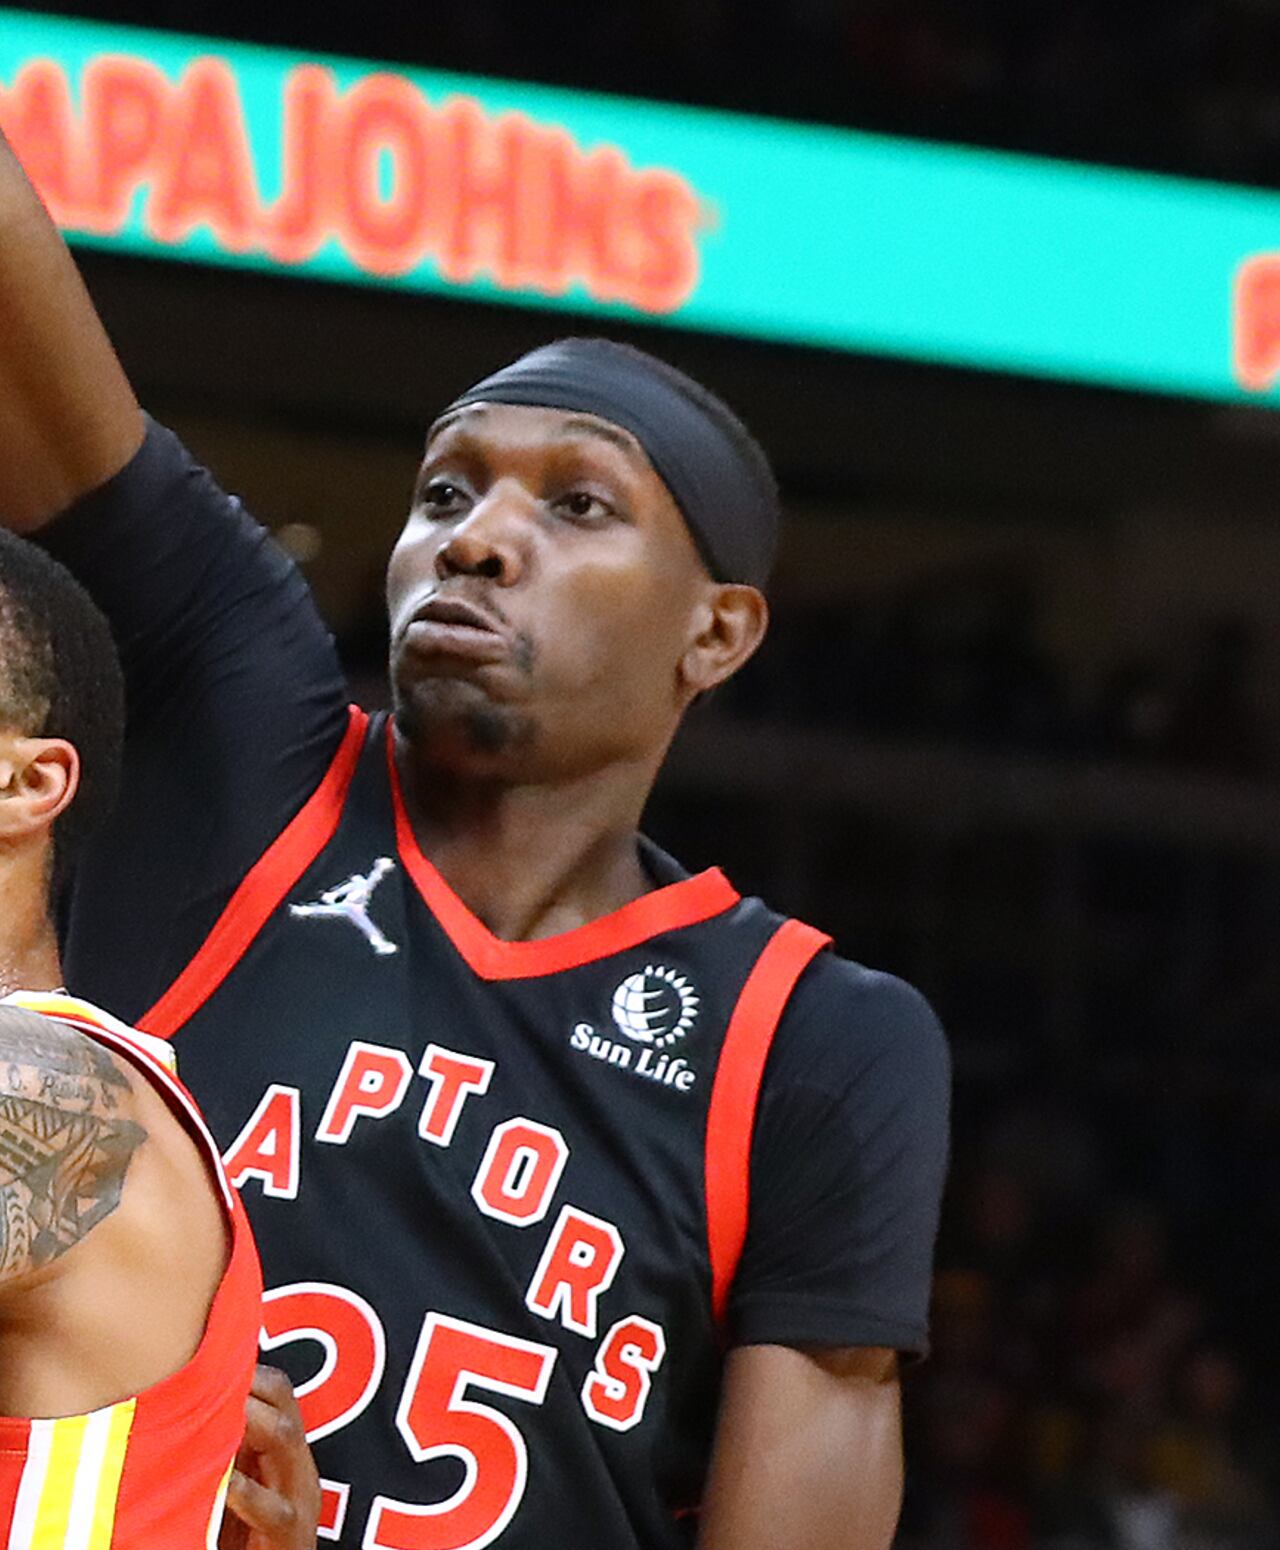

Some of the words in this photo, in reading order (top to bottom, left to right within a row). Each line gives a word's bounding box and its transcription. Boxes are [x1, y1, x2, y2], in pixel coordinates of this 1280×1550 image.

[570, 1023, 632, 1069] Sun
[635, 1048, 696, 1091] Life
[222, 1040, 666, 1432] APTORS
